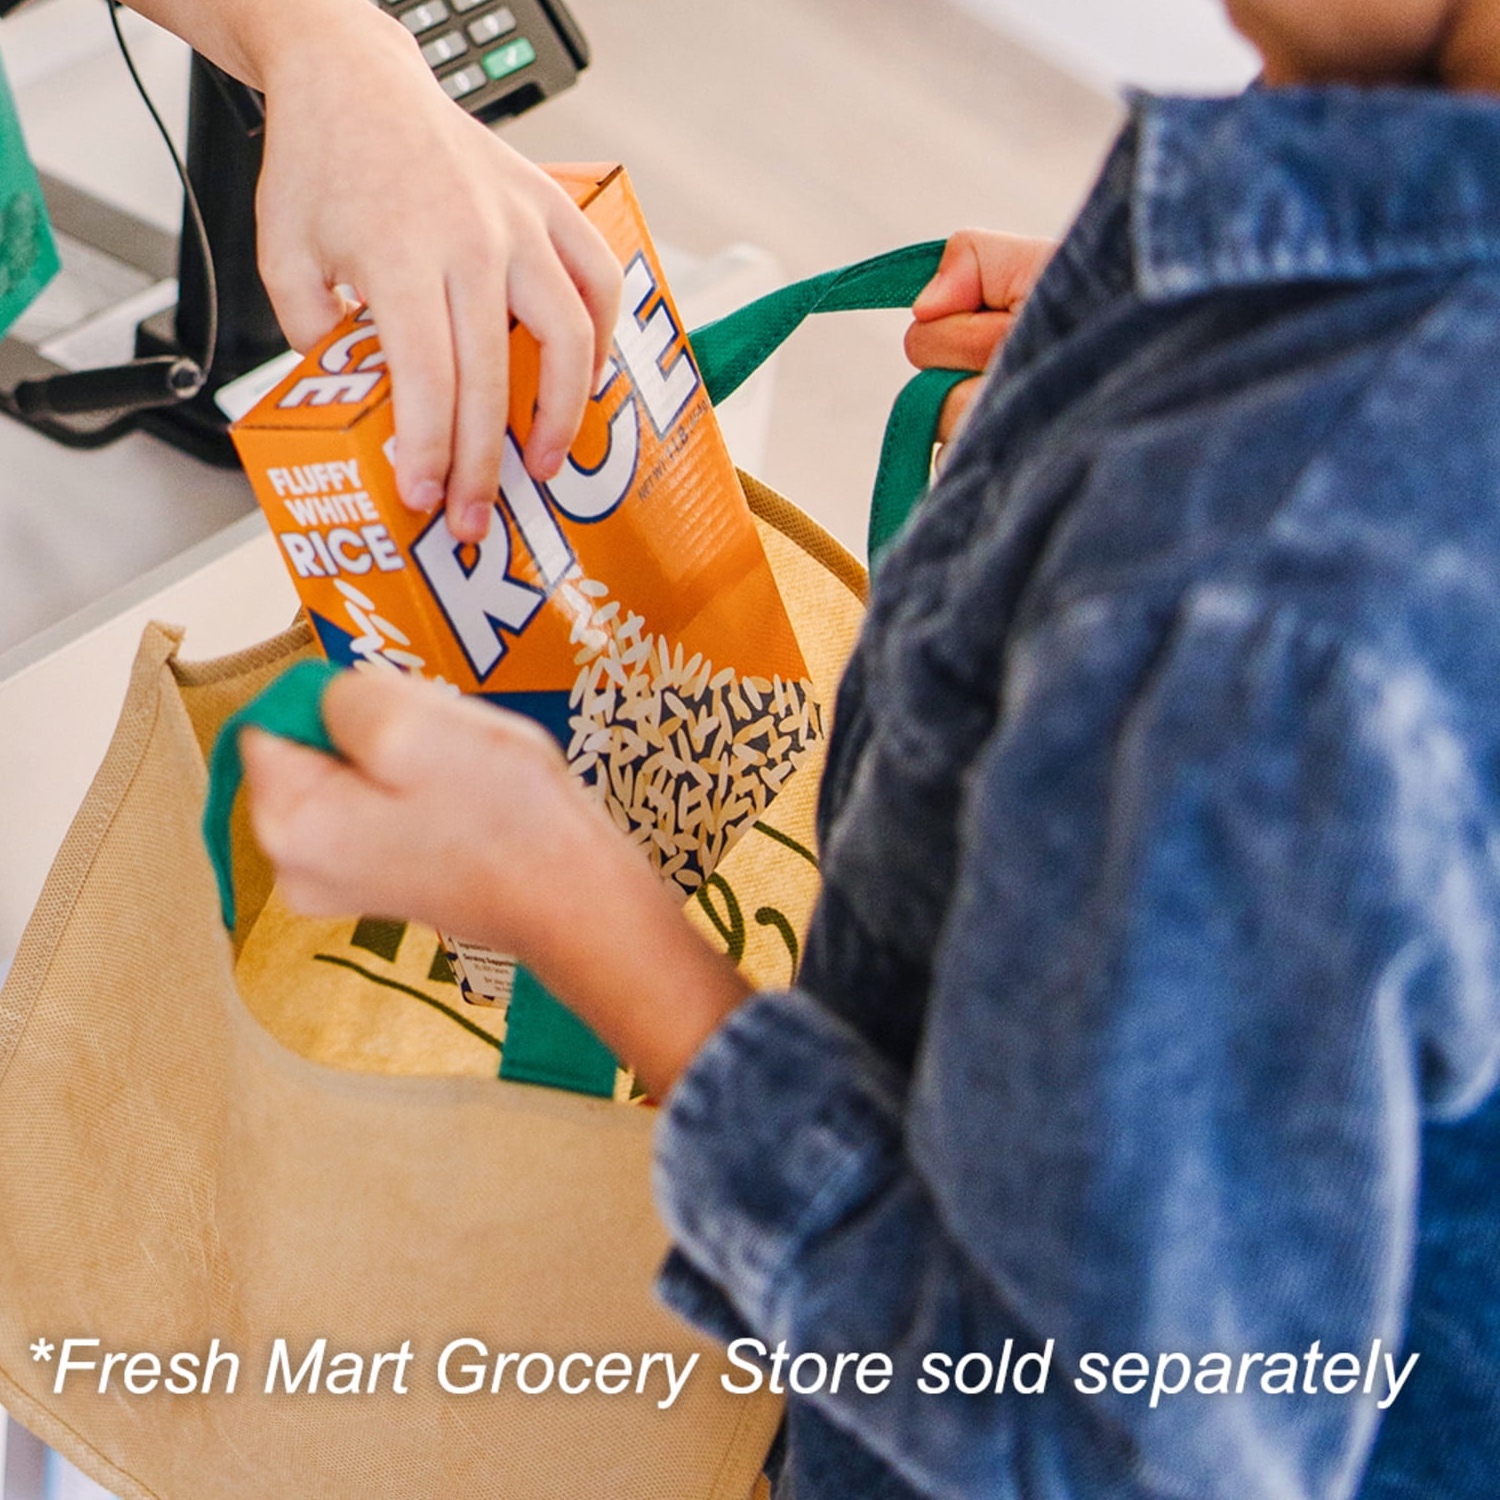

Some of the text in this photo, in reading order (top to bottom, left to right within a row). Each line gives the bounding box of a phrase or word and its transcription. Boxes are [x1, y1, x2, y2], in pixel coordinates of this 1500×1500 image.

[267, 459, 363, 497] FLUFFY
[410, 249, 701, 686] RICE
[283, 491, 380, 527] WHITE
[279, 523, 406, 578] RICE
